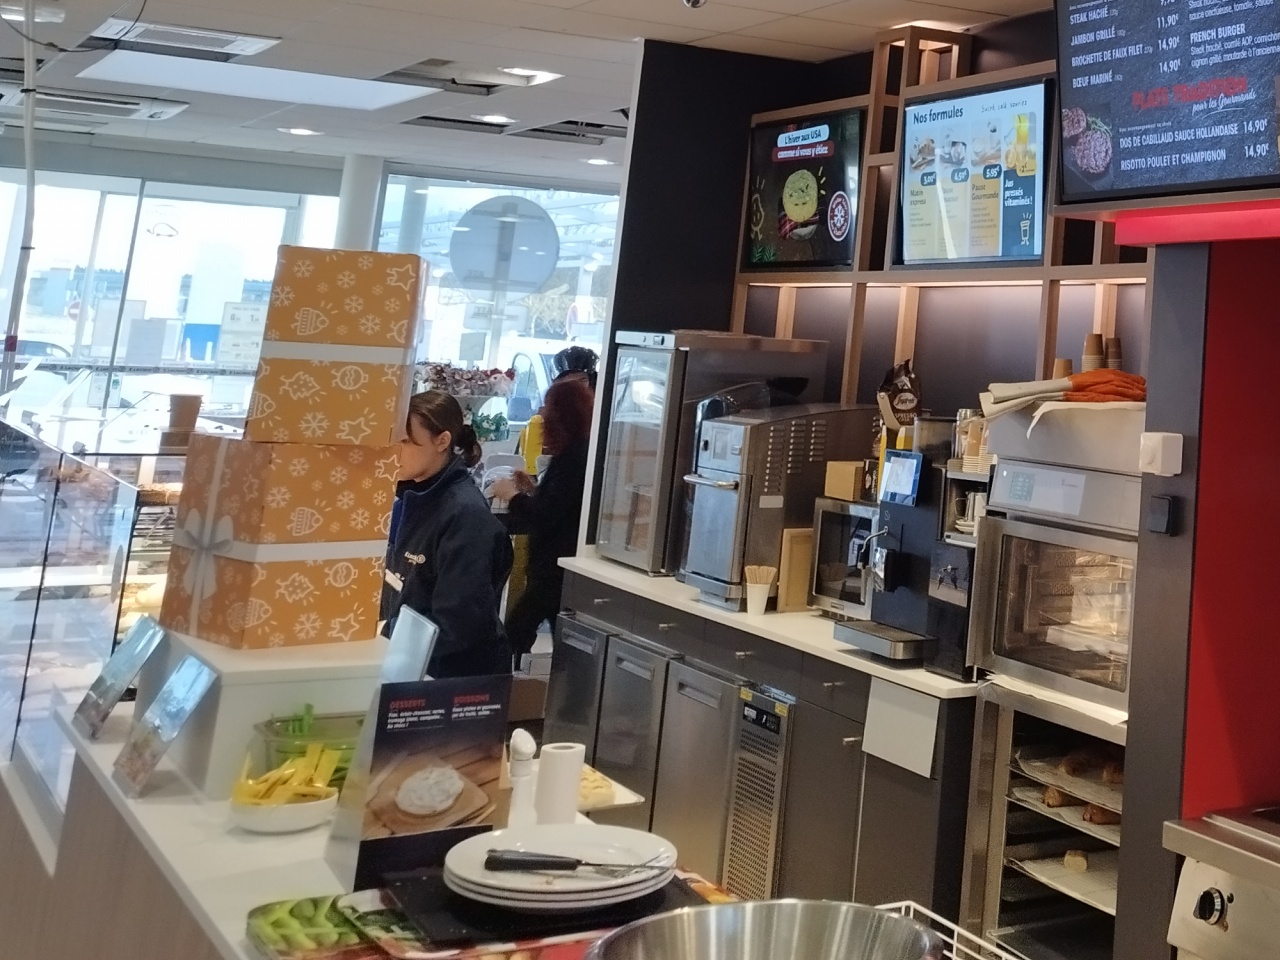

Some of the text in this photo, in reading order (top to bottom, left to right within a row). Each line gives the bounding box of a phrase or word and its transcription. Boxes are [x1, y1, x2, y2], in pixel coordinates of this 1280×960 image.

[1070, 12, 1088, 25] STEAK
[1070, 32, 1094, 46] JAMBON
[1190, 24, 1246, 44] FRENCH BURGER
[1072, 44, 1143, 67] BROCHETTE DE FAUX FILET
[913, 111, 928, 124] Nos
[928, 105, 964, 123] formules
[810, 129, 822, 140] USA
[1120, 122, 1238, 149] DOS DE CABILLAUD SAUCE HOLLANDAISE
[1120, 148, 1226, 171] RISOTTO POULET ET CHAMPIGNON
